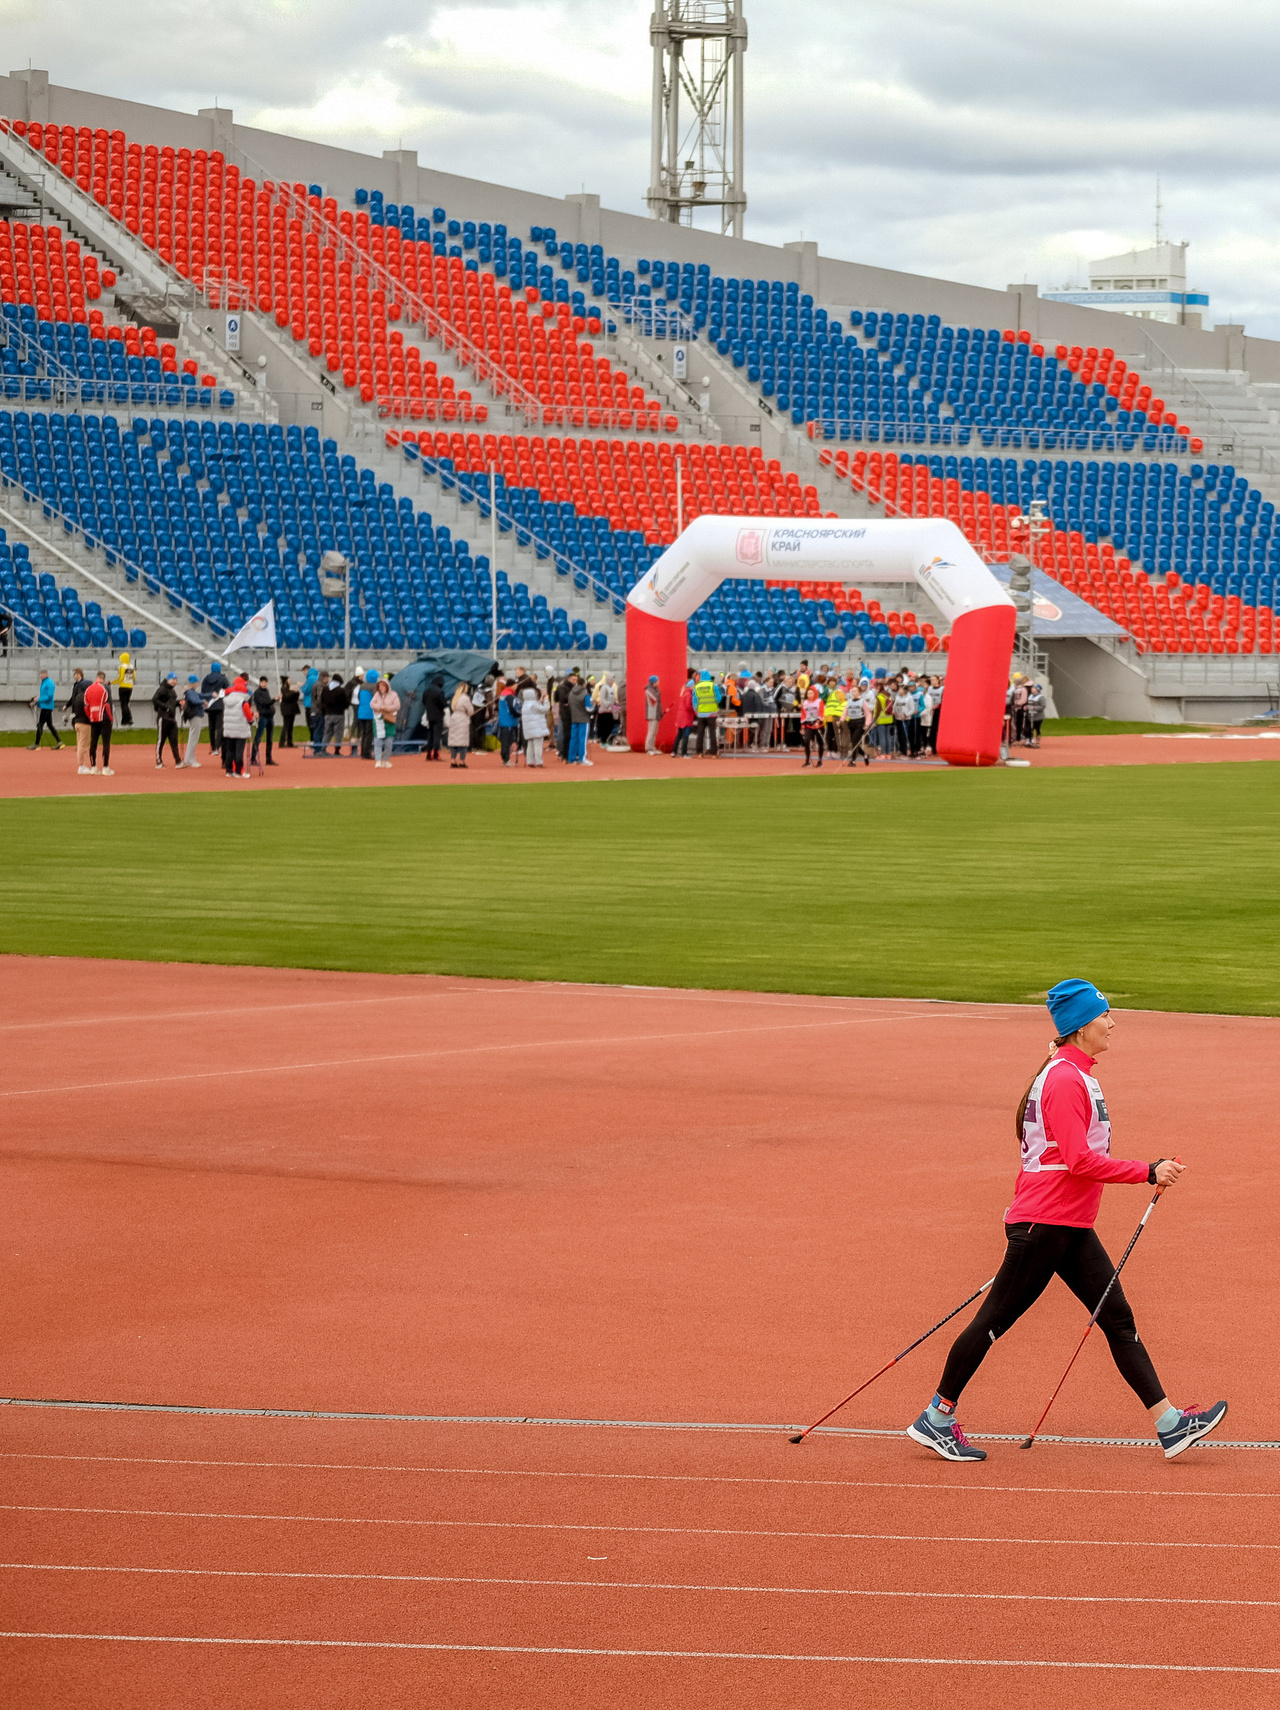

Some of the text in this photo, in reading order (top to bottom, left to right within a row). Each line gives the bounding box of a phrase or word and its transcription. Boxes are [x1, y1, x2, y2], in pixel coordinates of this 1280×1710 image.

[773, 528, 866, 539] КРАСНОЯРСКИЙ
[771, 540, 801, 552] КРАЙ
[772, 559, 875, 569] МИНИСТЕРСТВО СПОРТА
